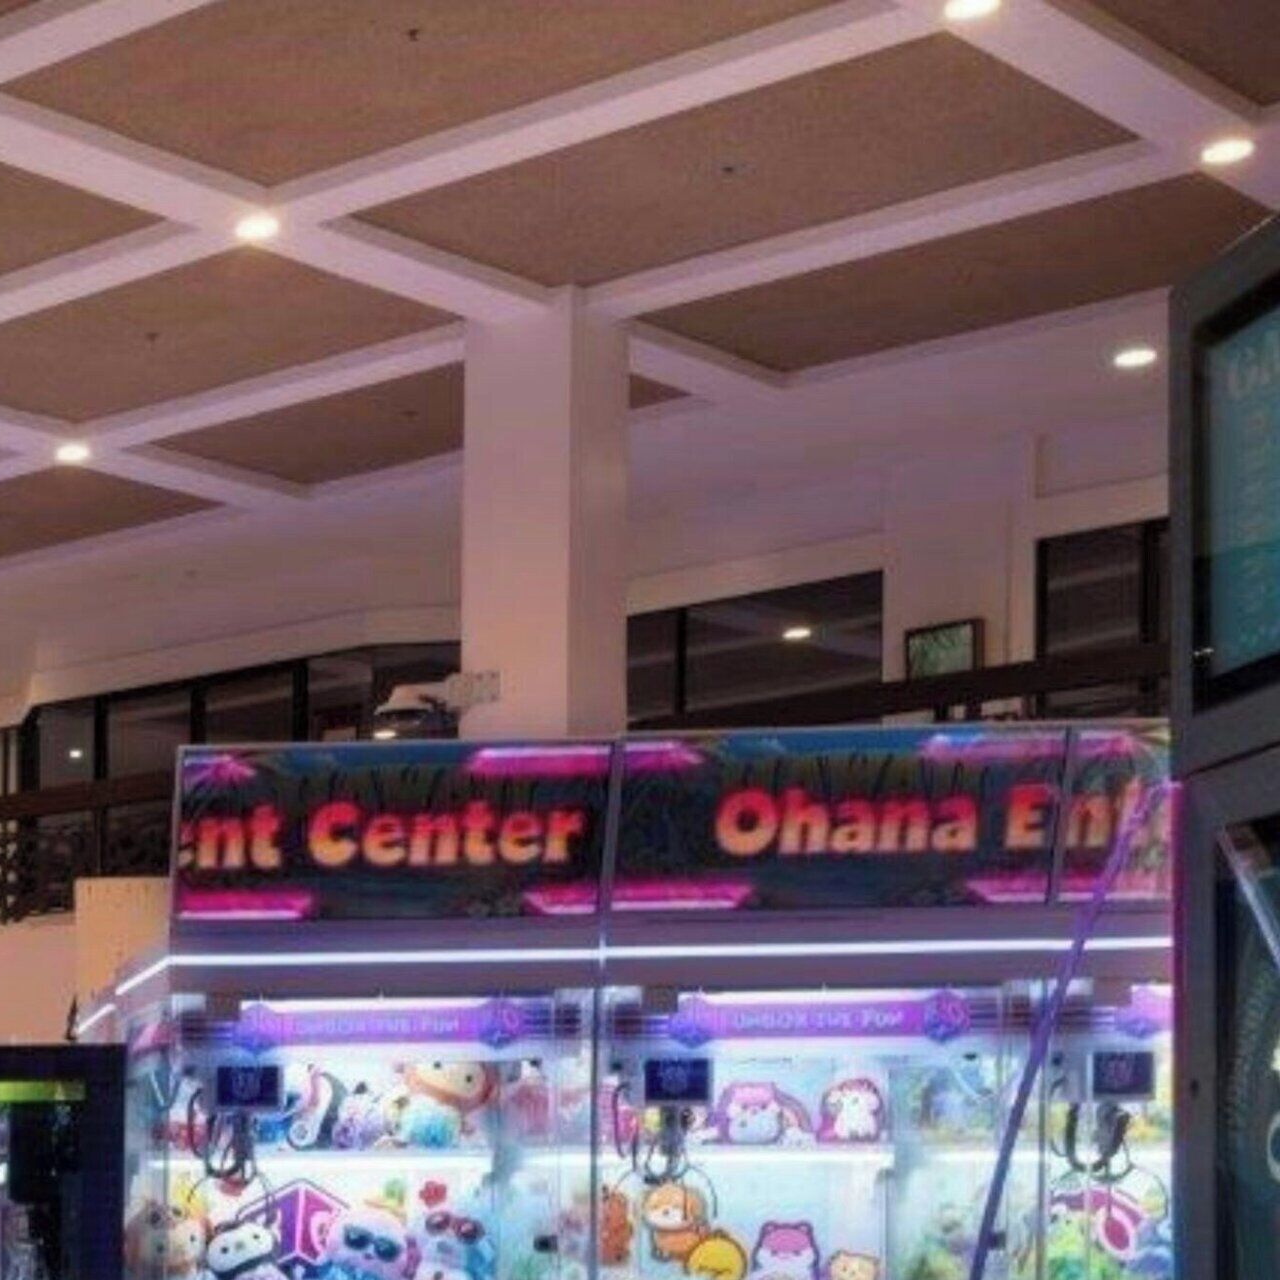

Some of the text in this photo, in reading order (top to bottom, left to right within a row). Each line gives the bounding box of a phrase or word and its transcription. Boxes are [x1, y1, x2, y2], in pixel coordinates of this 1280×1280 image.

[180, 801, 586, 869] nt Center
[714, 785, 978, 856] Ohana
